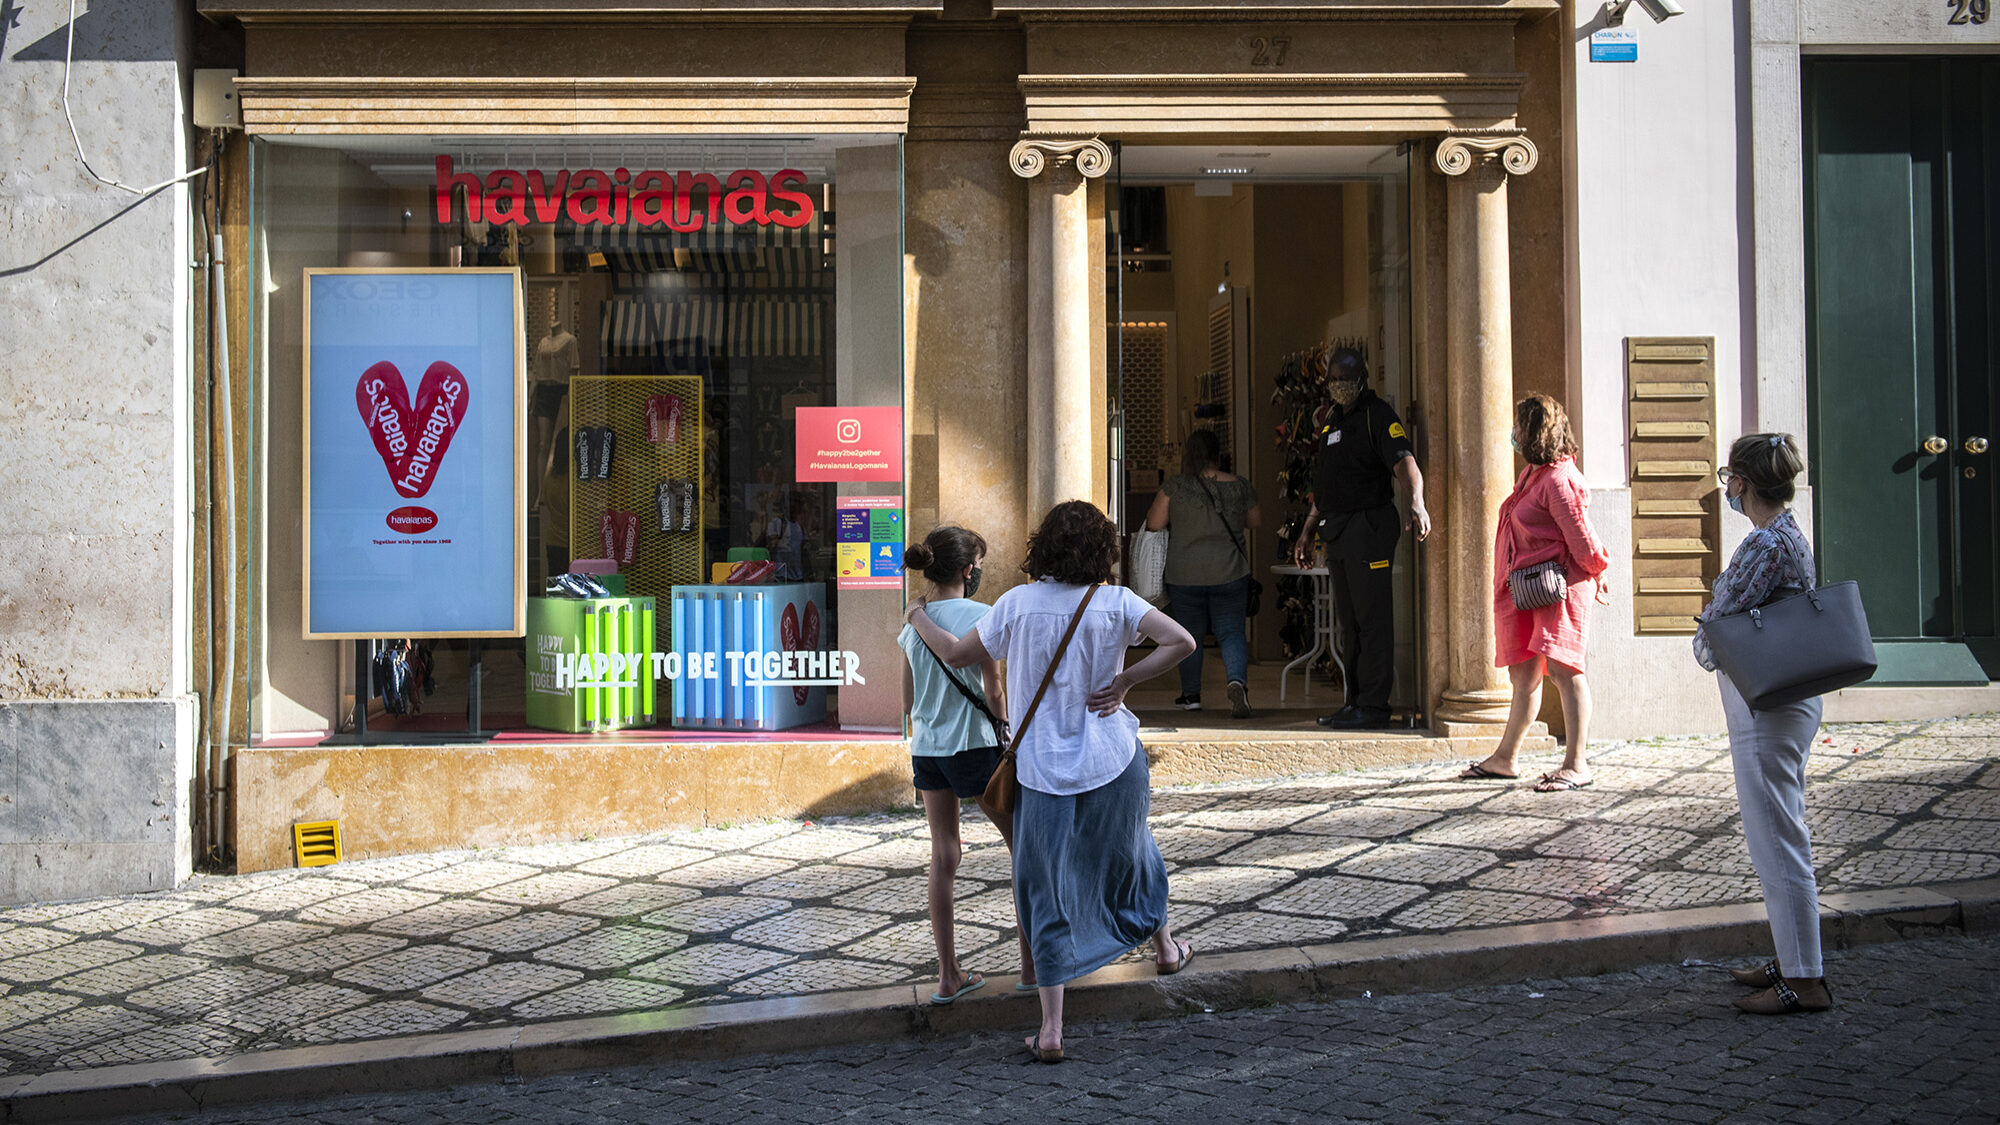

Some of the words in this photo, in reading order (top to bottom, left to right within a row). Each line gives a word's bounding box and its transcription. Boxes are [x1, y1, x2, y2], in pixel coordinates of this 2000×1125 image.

[1947, 0, 1990, 25] 29
[1250, 36, 1292, 65] 27
[435, 154, 815, 232] havaianas
[817, 449, 881, 458] #happy2be2gether
[809, 462, 889, 471] #HavaianasLogomania
[391, 515, 433, 525] havaianas
[537, 634, 563, 654] HAPPY
[540, 655, 550, 672] TO
[556, 653, 643, 688] HAPPY
[650, 652, 682, 679] TO
[688, 652, 718, 679] BE
[725, 650, 866, 686] TOGETHER
